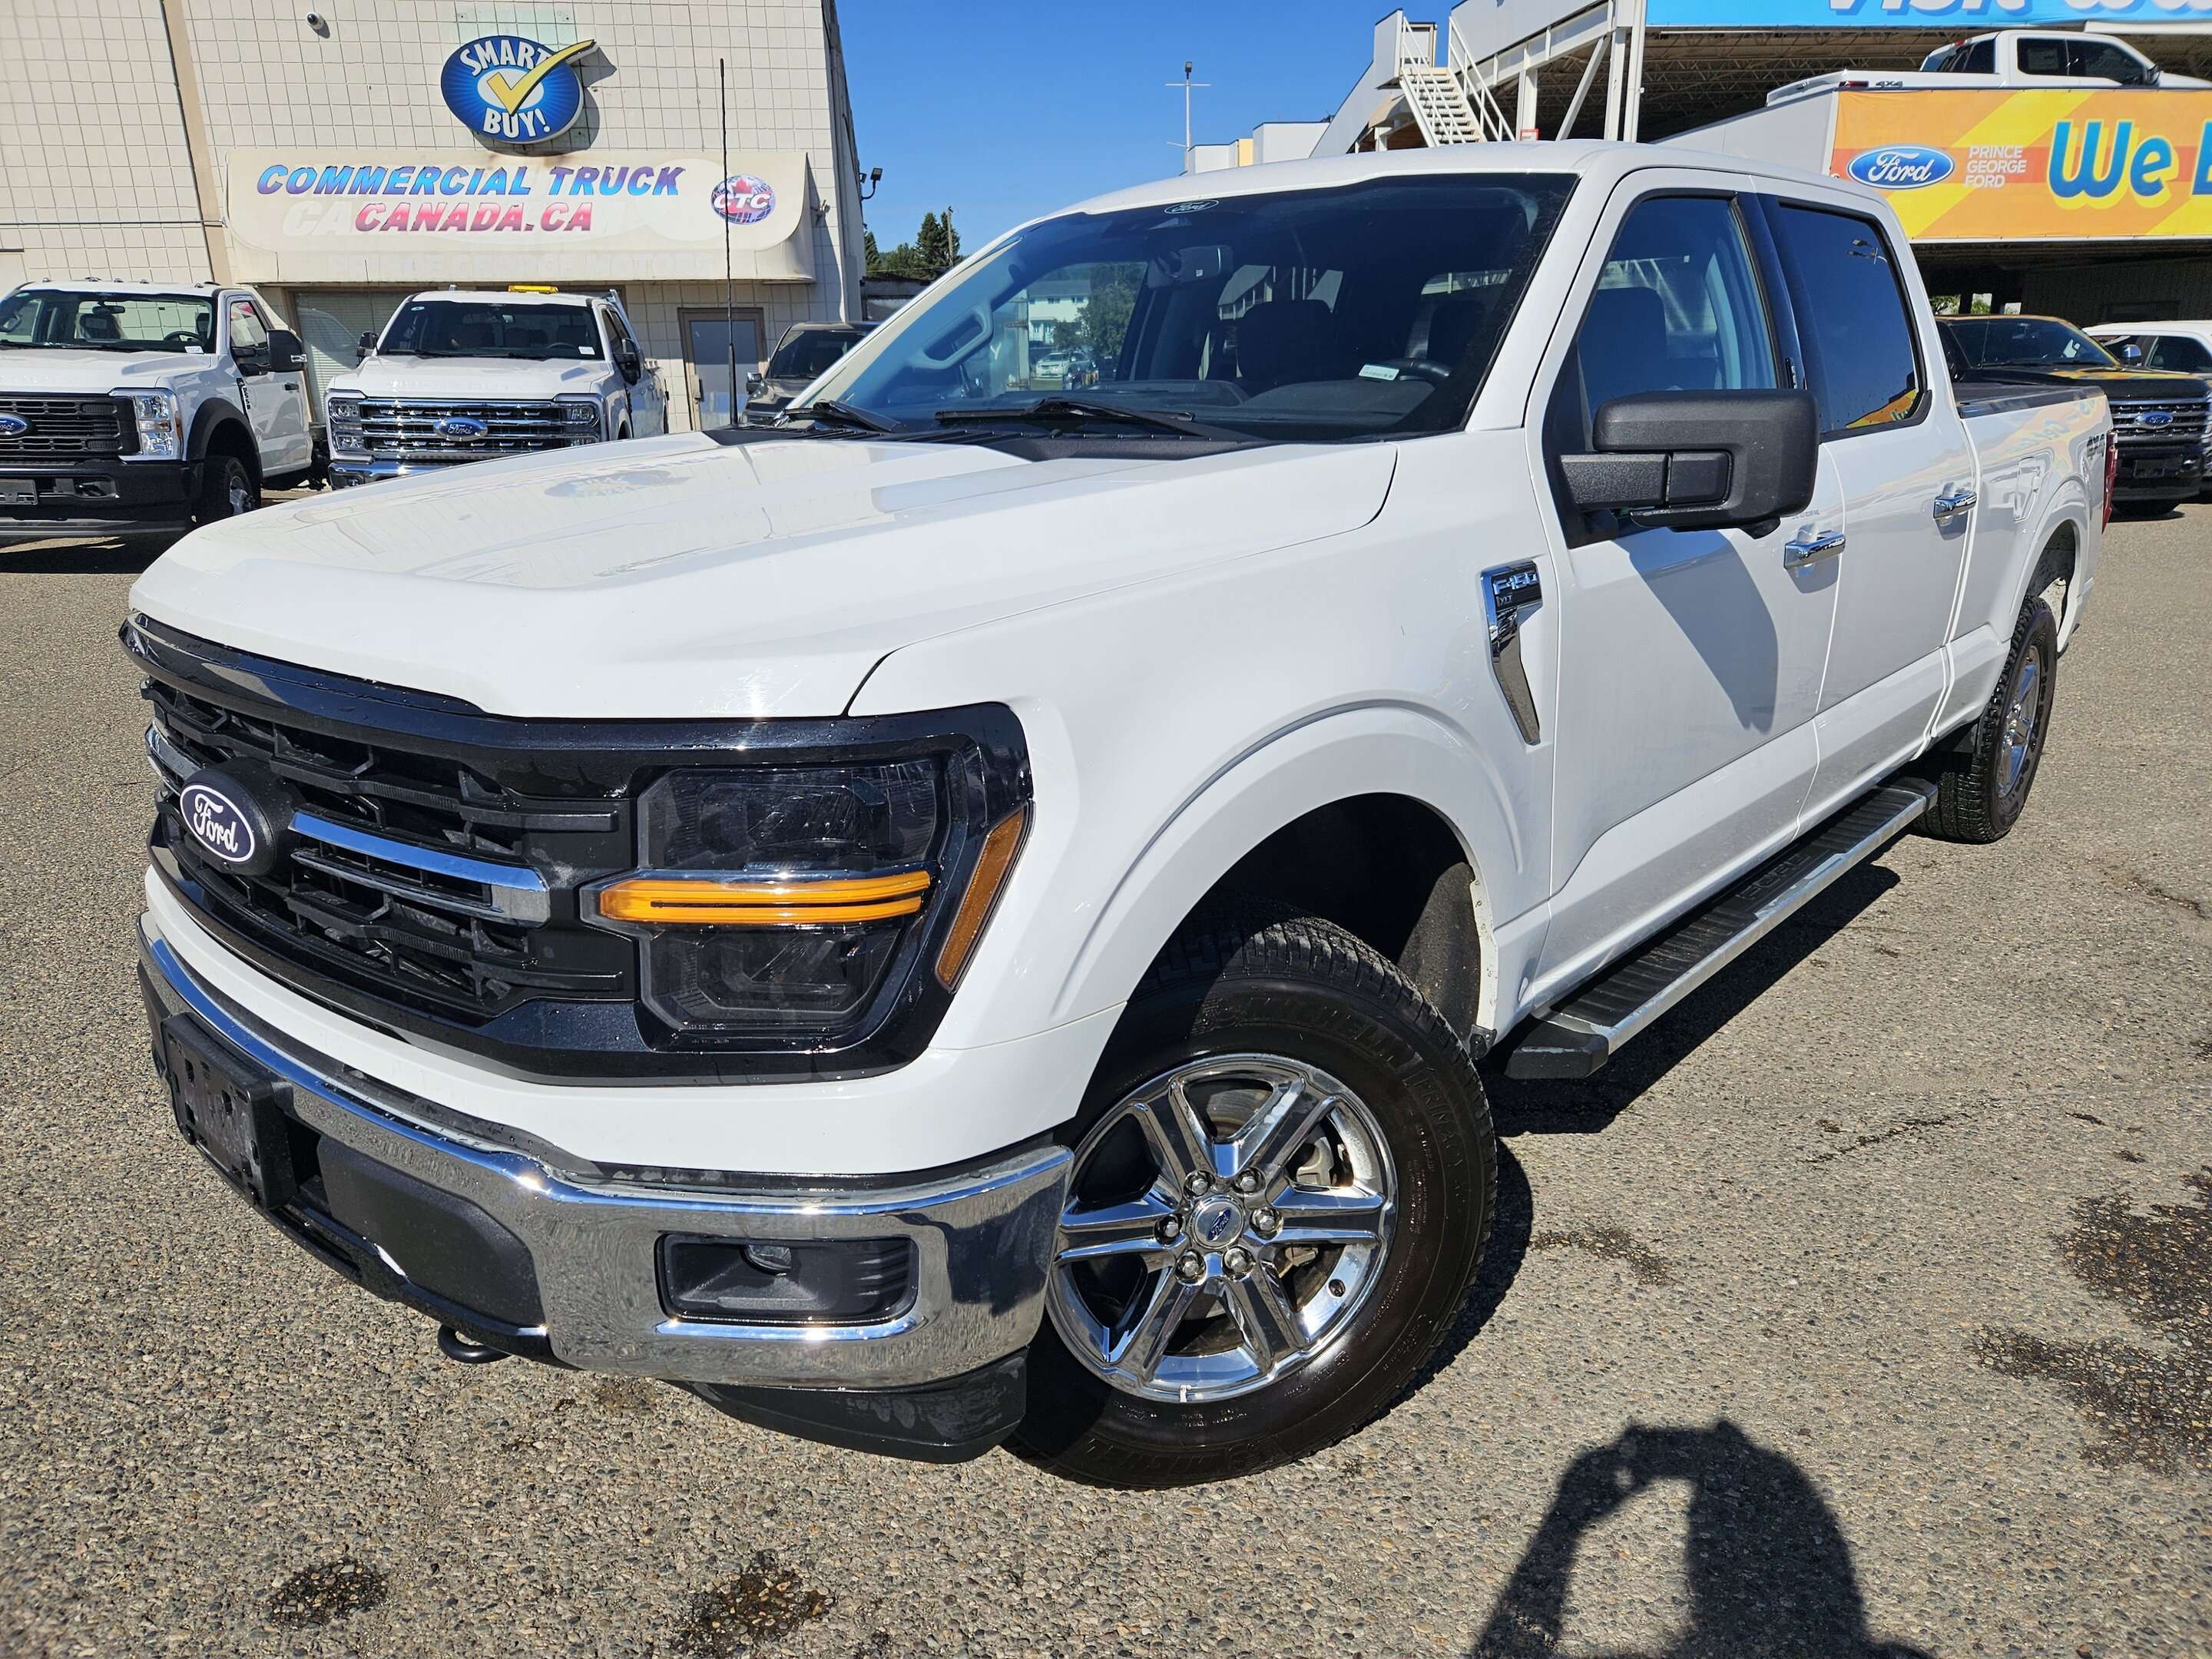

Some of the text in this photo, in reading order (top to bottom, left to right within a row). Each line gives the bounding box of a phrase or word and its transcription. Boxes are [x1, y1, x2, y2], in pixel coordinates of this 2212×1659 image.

[459, 39, 553, 76] SMART
[482, 108, 551, 139] BUY!
[1867, 151, 1933, 184] Ford
[1966, 160, 2027, 174] GEORGE
[1969, 146, 2023, 159] PRINCE
[2048, 120, 2173, 199] We
[257, 164, 687, 196] COMMERCIAL TRUCK
[1964, 174, 2005, 189] FORD
[355, 202, 593, 233] CANADA.CA
[447, 424, 472, 434] Ford
[193, 793, 238, 853] Ford
